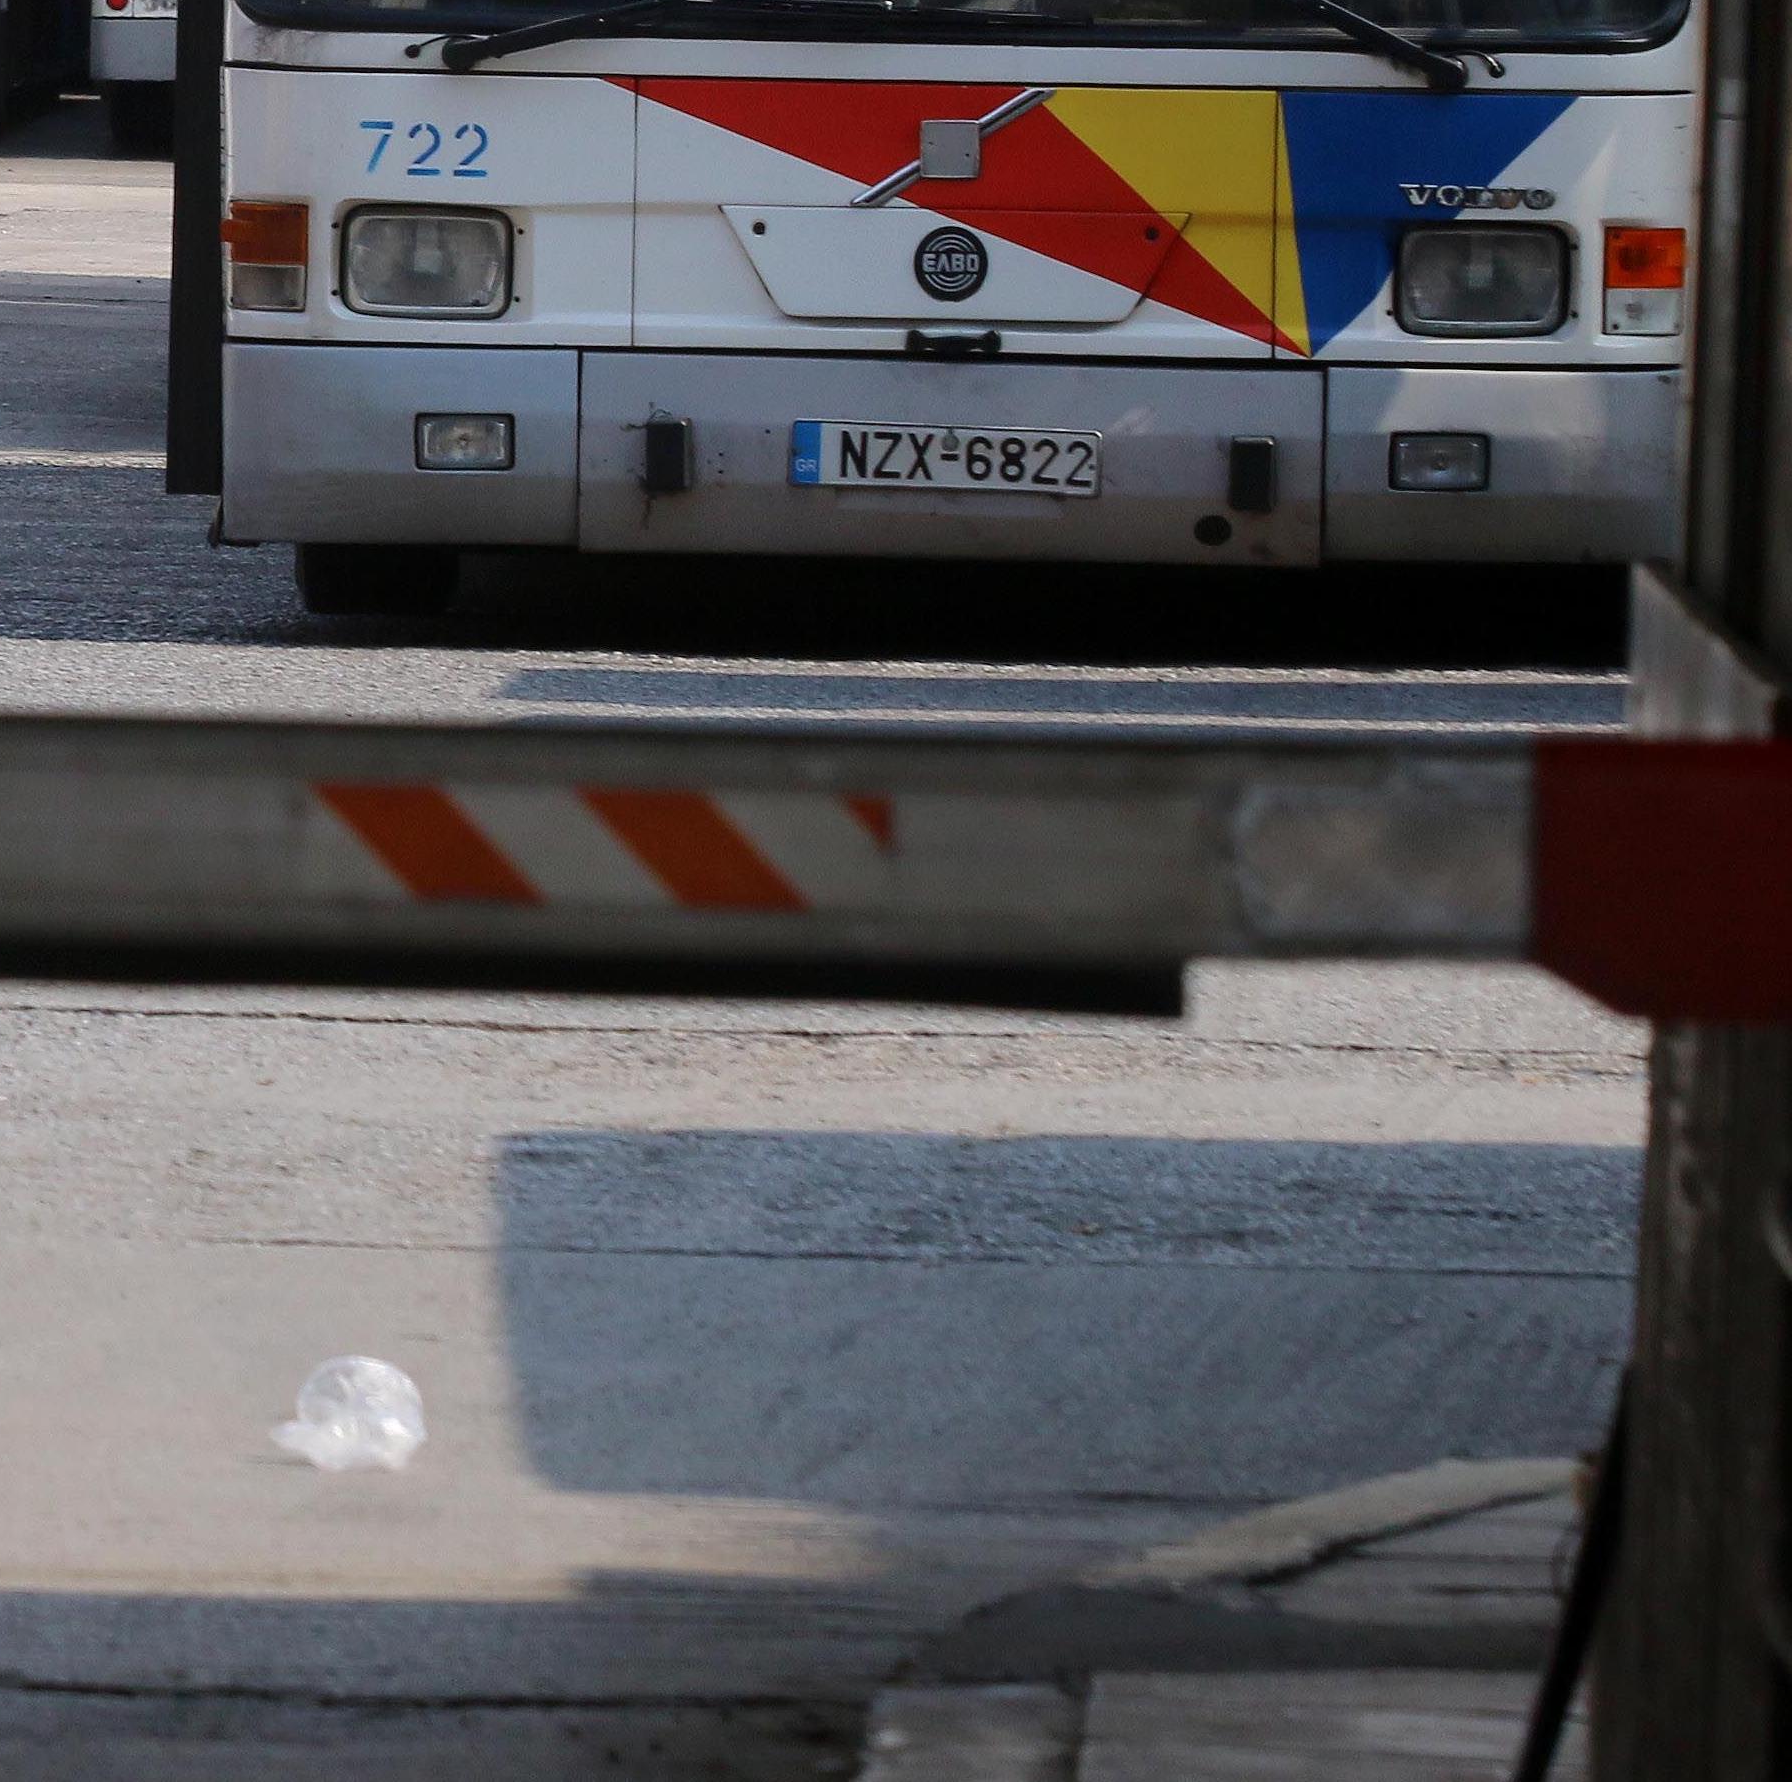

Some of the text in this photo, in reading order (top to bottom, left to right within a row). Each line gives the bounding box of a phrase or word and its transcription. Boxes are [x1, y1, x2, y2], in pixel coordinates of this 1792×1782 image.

[359, 120, 489, 178] 722
[1398, 182, 1557, 210] VOLVO
[794, 457, 817, 473] GR
